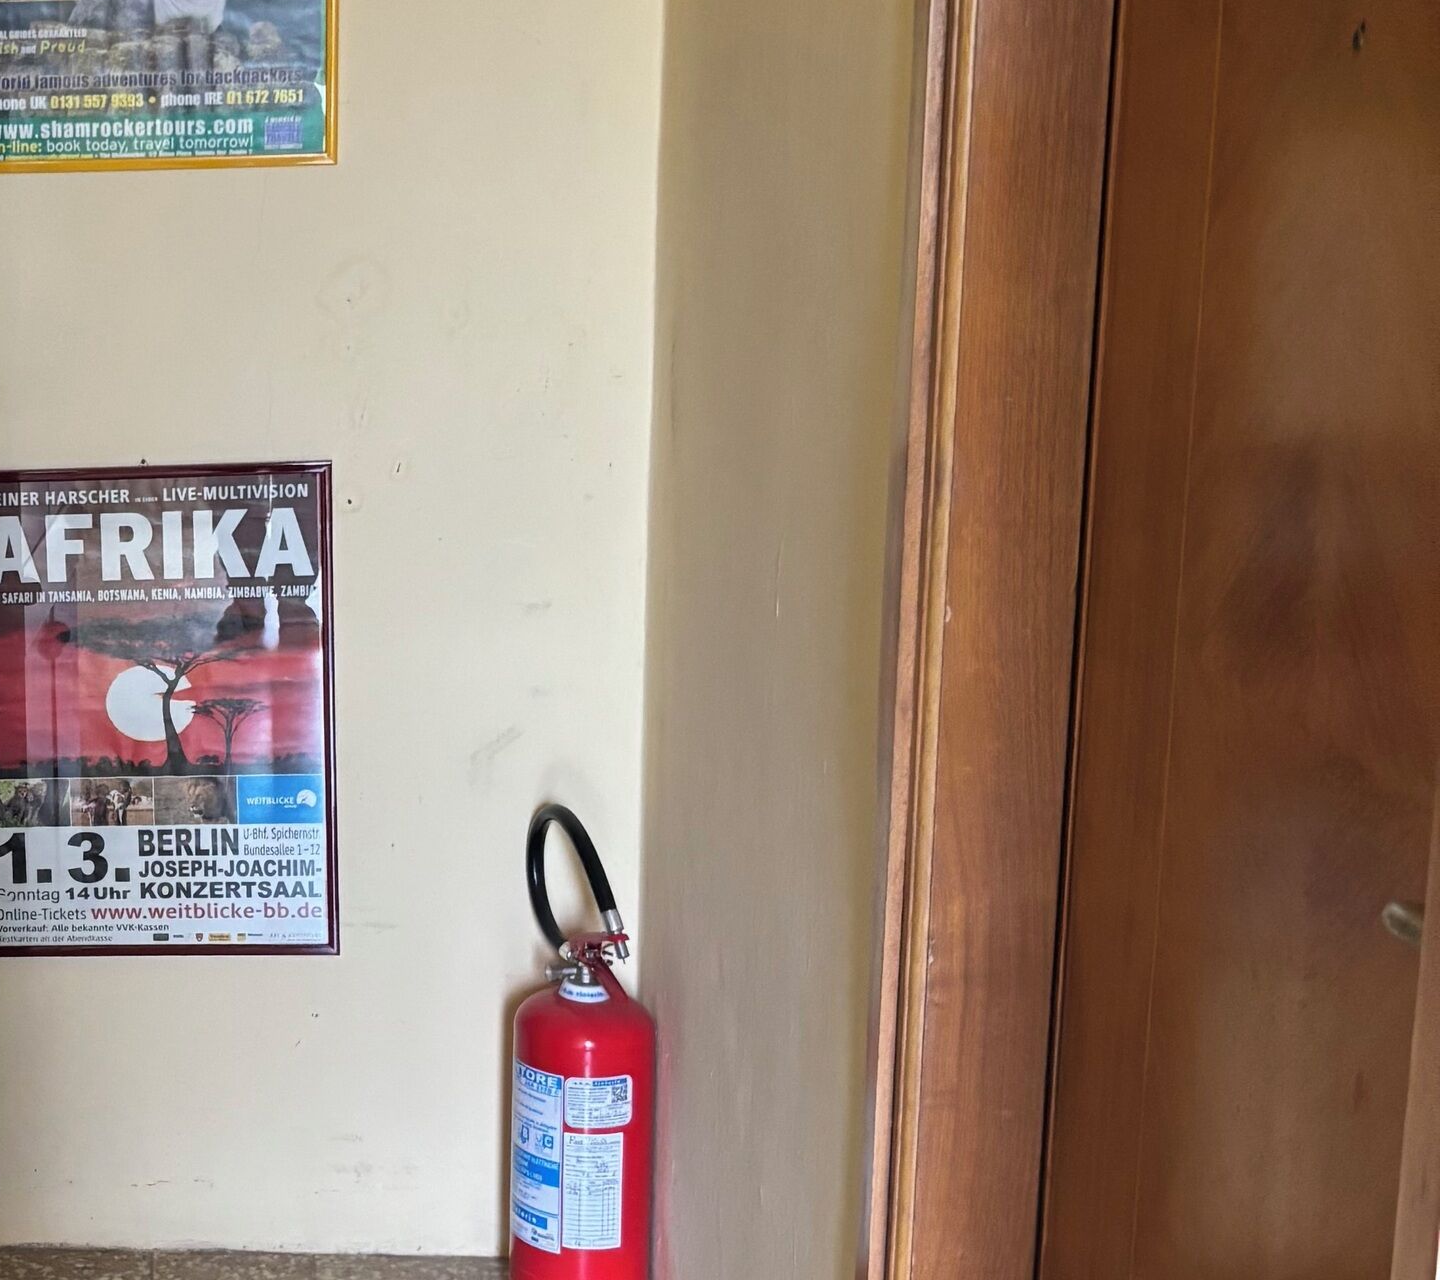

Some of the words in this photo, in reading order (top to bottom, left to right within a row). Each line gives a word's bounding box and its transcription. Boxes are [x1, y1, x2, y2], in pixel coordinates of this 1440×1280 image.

[9, 29, 37, 40] GUIDES
[38, 27, 88, 39] GUARANTEED
[21, 44, 37, 54] and
[40, 39, 86, 55] Proud
[34, 74, 90, 91] famous
[93, 71, 177, 89] adventures
[181, 69, 202, 86] for
[205, 67, 302, 88] backpackers
[30, 95, 48, 110] UK
[50, 94, 81, 110] 0131
[83, 94, 107, 109] 557
[111, 93, 145, 109] 9393
[161, 93, 201, 108] phone
[204, 91, 224, 106] IRE
[226, 91, 243, 105] 01
[245, 90, 269, 105] 672
[272, 88, 305, 104] 7651
[46, 139, 82, 153] book
[85, 137, 129, 154] today,
[132, 134, 175, 151] travel
[178, 132, 254, 150] tomorrow!
[45, 488, 130, 506] HARSCHER
[162, 482, 309, 503] LIVE-MULTIVISION
[2, 590, 33, 604] SAFARI
[36, 590, 46, 604] IN
[48, 589, 95, 603] TANSANIA,
[97, 587, 149, 603] BOTSWANA,
[151, 587, 182, 602] KENIA,
[184, 586, 226, 600] NAMIBIA,
[228, 584, 278, 600] ZIMBABWE,
[246, 796, 295, 806] WEITBLICKE
[137, 828, 240, 857] BERLIN
[243, 828, 269, 841] U-Bhf.
[243, 843, 295, 856] Bundesallee
[138, 859, 322, 879] JOSEPH-JOACHIM-
[65, 887, 91, 900] 14
[93, 886, 131, 900] Uhr
[140, 880, 322, 900] KONZERTSAAL
[91, 901, 323, 923] www.weitblicke-bb.de
[51, 924, 69, 932] Alle
[71, 923, 114, 932] bekannte
[52, 935, 65, 943] der
[67, 934, 113, 943] Abendkasse
